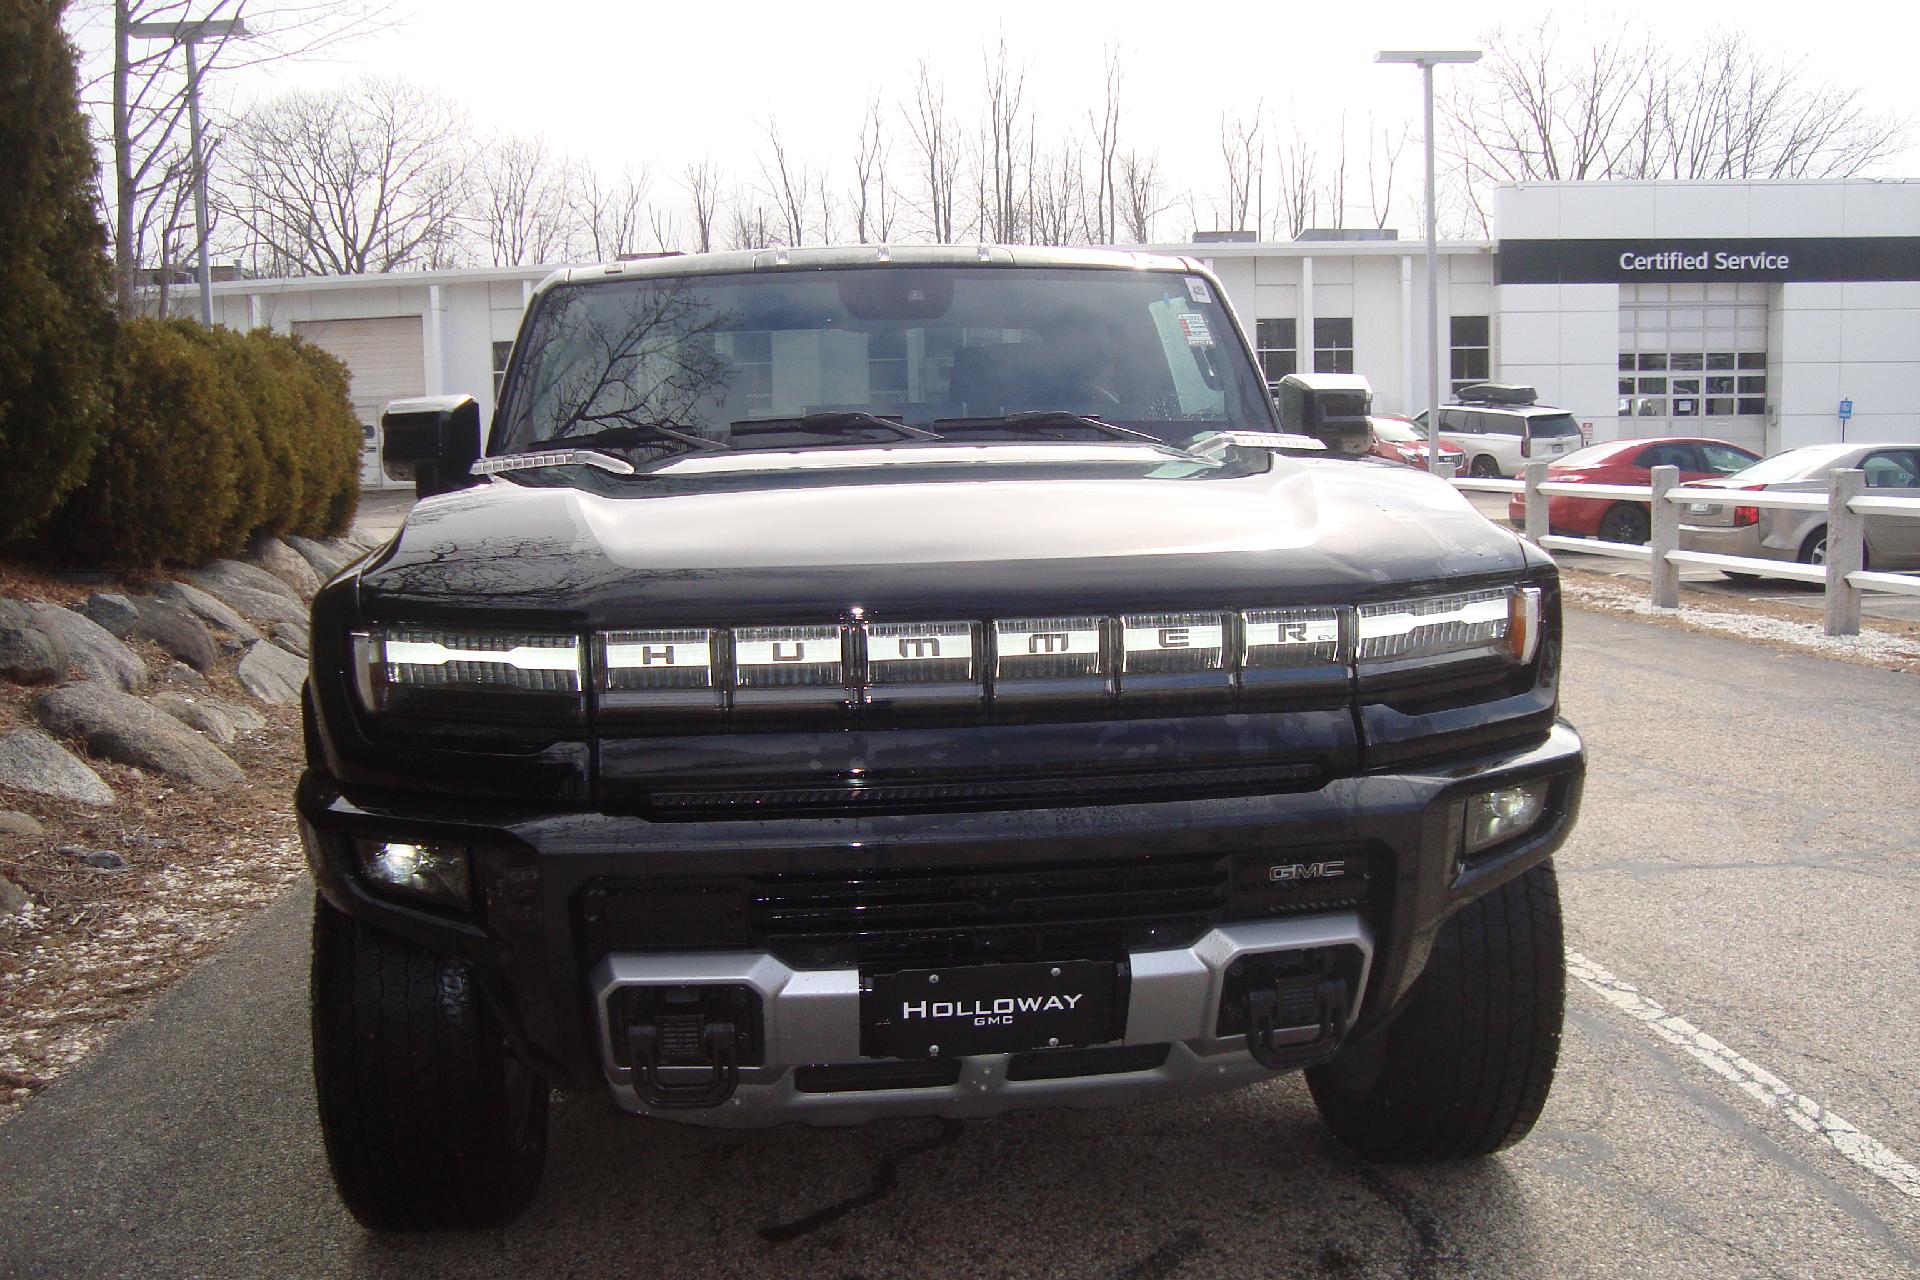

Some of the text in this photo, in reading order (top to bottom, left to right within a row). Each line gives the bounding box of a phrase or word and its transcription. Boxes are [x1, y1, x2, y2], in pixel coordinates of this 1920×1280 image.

[1619, 251, 1789, 270] Certified Service
[642, 622, 1306, 665] HUMMER
[1269, 860, 1345, 881] GMC
[903, 993, 1083, 1019] HOLLOWAY
[974, 1015, 1014, 1026] GMC
